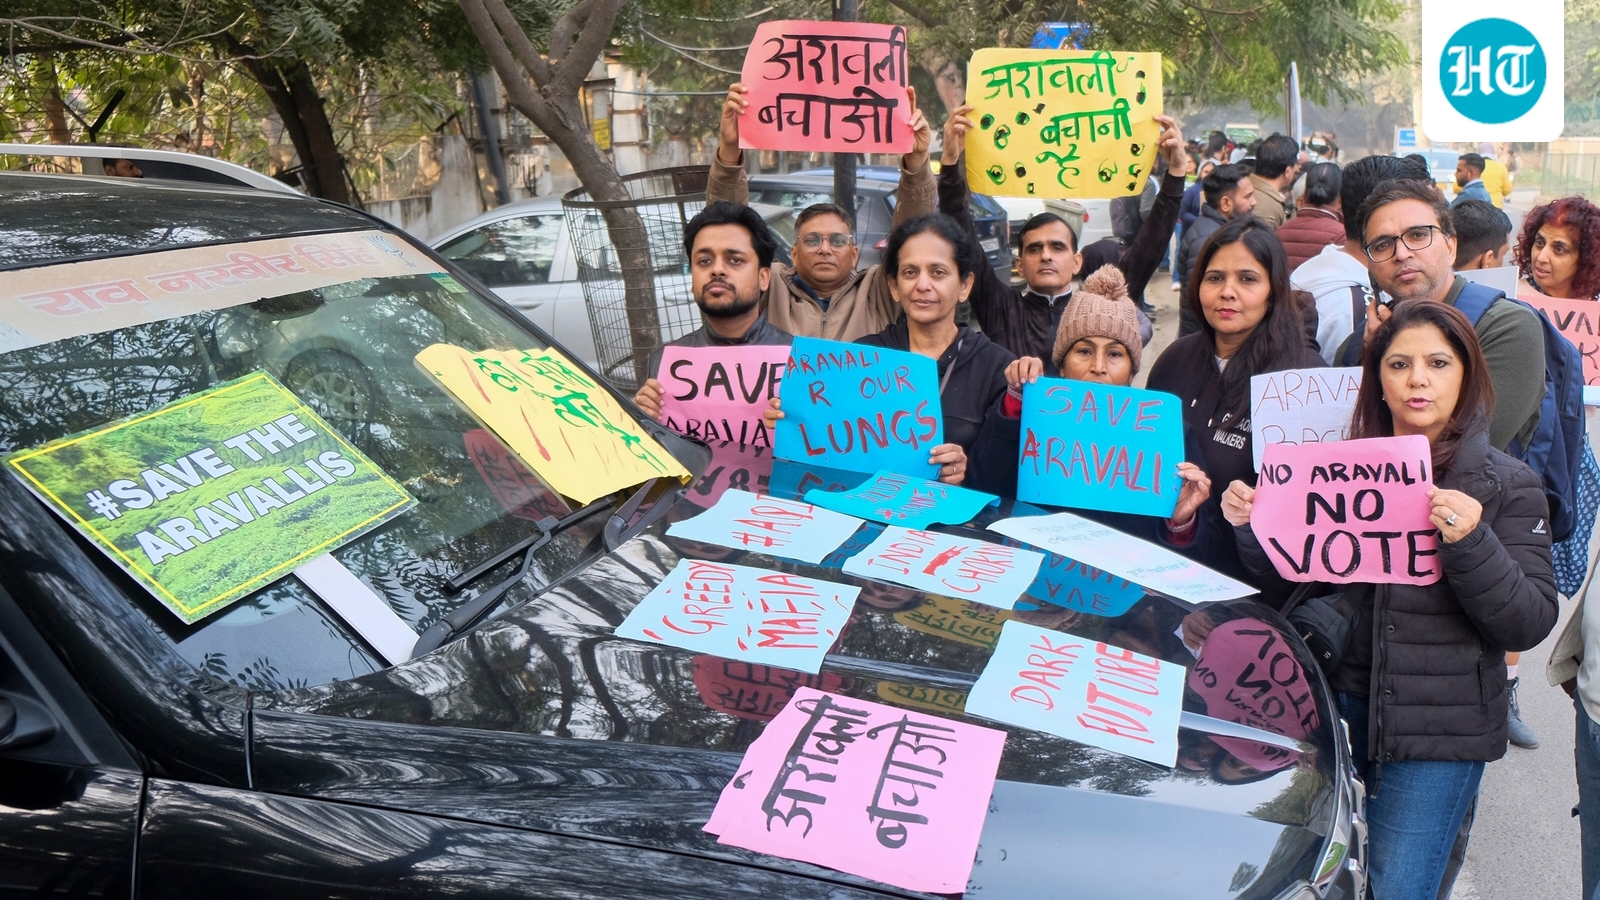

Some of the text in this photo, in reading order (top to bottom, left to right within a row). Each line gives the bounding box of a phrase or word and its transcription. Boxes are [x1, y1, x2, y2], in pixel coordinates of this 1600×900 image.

[762, 26, 906, 88] अरावली
[981, 50, 1117, 100] अरावली
[758, 86, 899, 144] बचाओ
[1040, 98, 1132, 146] बचानी
[1035, 143, 1081, 189] है
[17, 277, 149, 317] राव
[291, 242, 384, 271] सिंह
[786, 349, 881, 379] ARAVALI
[809, 365, 917, 407] R OUR
[798, 399, 937, 457] LUNGS
[1039, 386, 1163, 432] SAVE
[85, 413, 317, 521] #SAVE THE
[1020, 427, 1162, 495] ARAVALI
[1213, 428, 1246, 450] WALKERS
[1260, 460, 1427, 487] NO ARAVALI
[134, 450, 356, 565] ARAVALLIS
[731, 493, 815, 548] #AQI
[1305, 488, 1385, 526] NO
[867, 529, 941, 576] INDIA
[1268, 529, 1438, 578] VOTE
[662, 560, 736, 635] GREEDY
[756, 573, 823, 649] MAFIA
[1009, 635, 1085, 711] DARK
[1076, 641, 1162, 744] FUTURE
[761, 694, 873, 840] अरावली
[866, 713, 958, 849] बचाओ
